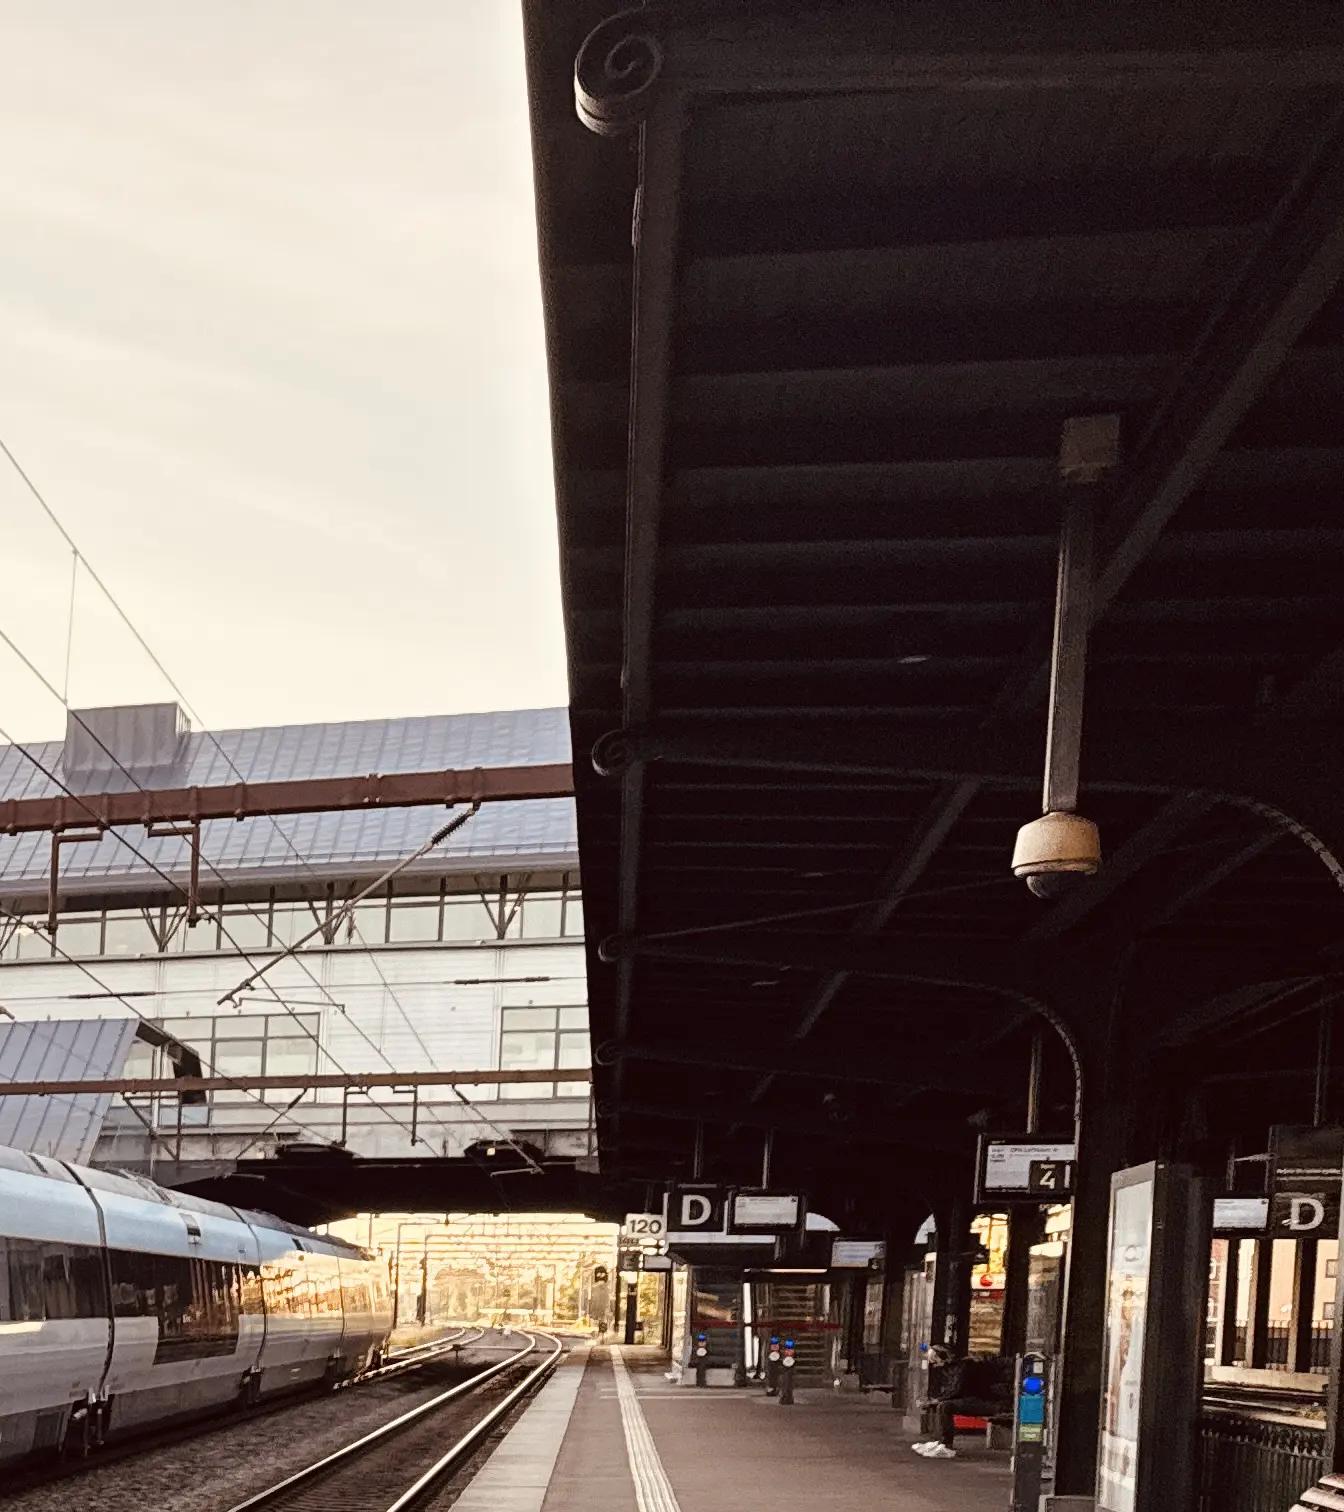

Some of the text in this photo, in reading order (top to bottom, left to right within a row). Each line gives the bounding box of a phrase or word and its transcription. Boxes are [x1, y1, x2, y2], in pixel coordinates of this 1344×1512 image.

[1039, 1170, 1056, 1189] 4
[681, 1194, 712, 1226] D
[1289, 1198, 1325, 1231] D
[630, 1219, 662, 1234] 120
